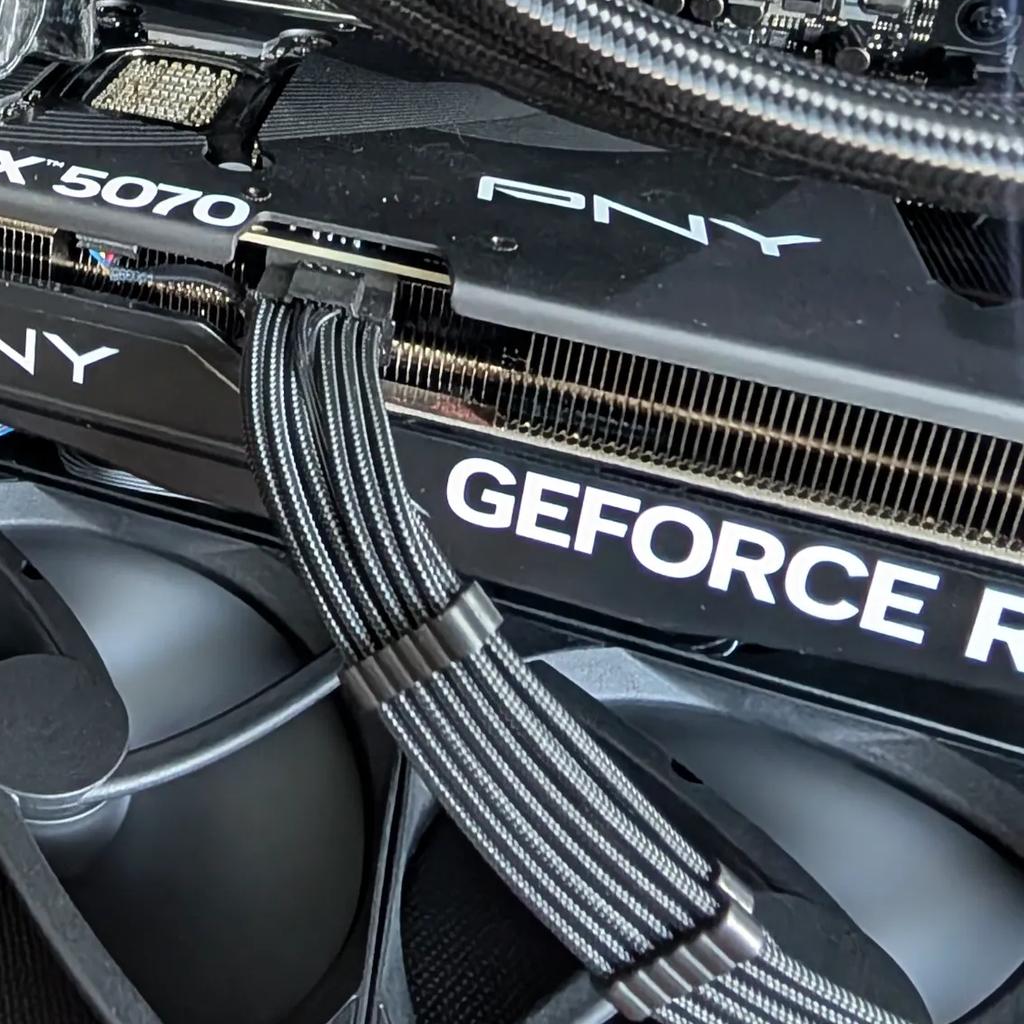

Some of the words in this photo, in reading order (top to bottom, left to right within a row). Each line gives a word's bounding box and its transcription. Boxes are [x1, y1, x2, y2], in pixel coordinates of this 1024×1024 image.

[51, 165, 251, 228] 5070
[477, 175, 822, 257] PNY
[445, 456, 942, 645] GEFORCE
